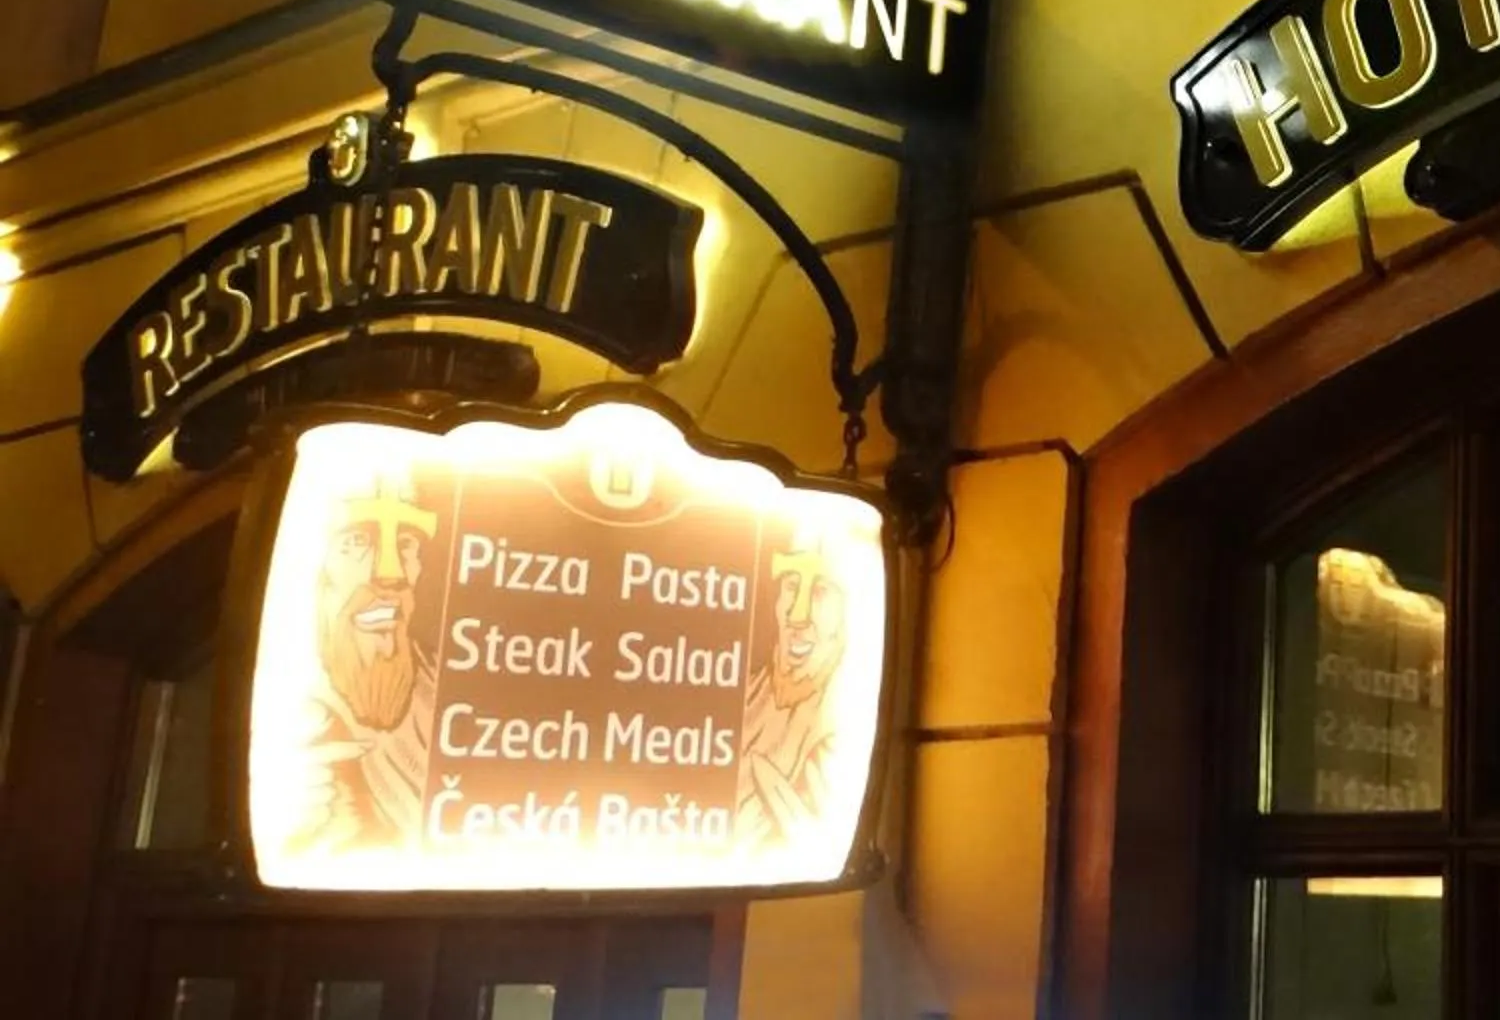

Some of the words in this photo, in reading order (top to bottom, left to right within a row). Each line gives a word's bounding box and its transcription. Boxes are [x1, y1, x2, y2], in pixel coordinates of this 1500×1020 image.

[128, 181, 612, 418] RESTAURANT
[458, 534, 590, 596] Pizza
[620, 552, 748, 611] Pasta
[446, 618, 592, 678] Steak
[614, 631, 742, 688] Salad
[438, 703, 590, 762] Czech
[604, 711, 735, 767] Meals
[427, 774, 581, 844] Česká
[596, 792, 732, 846] Bašta
